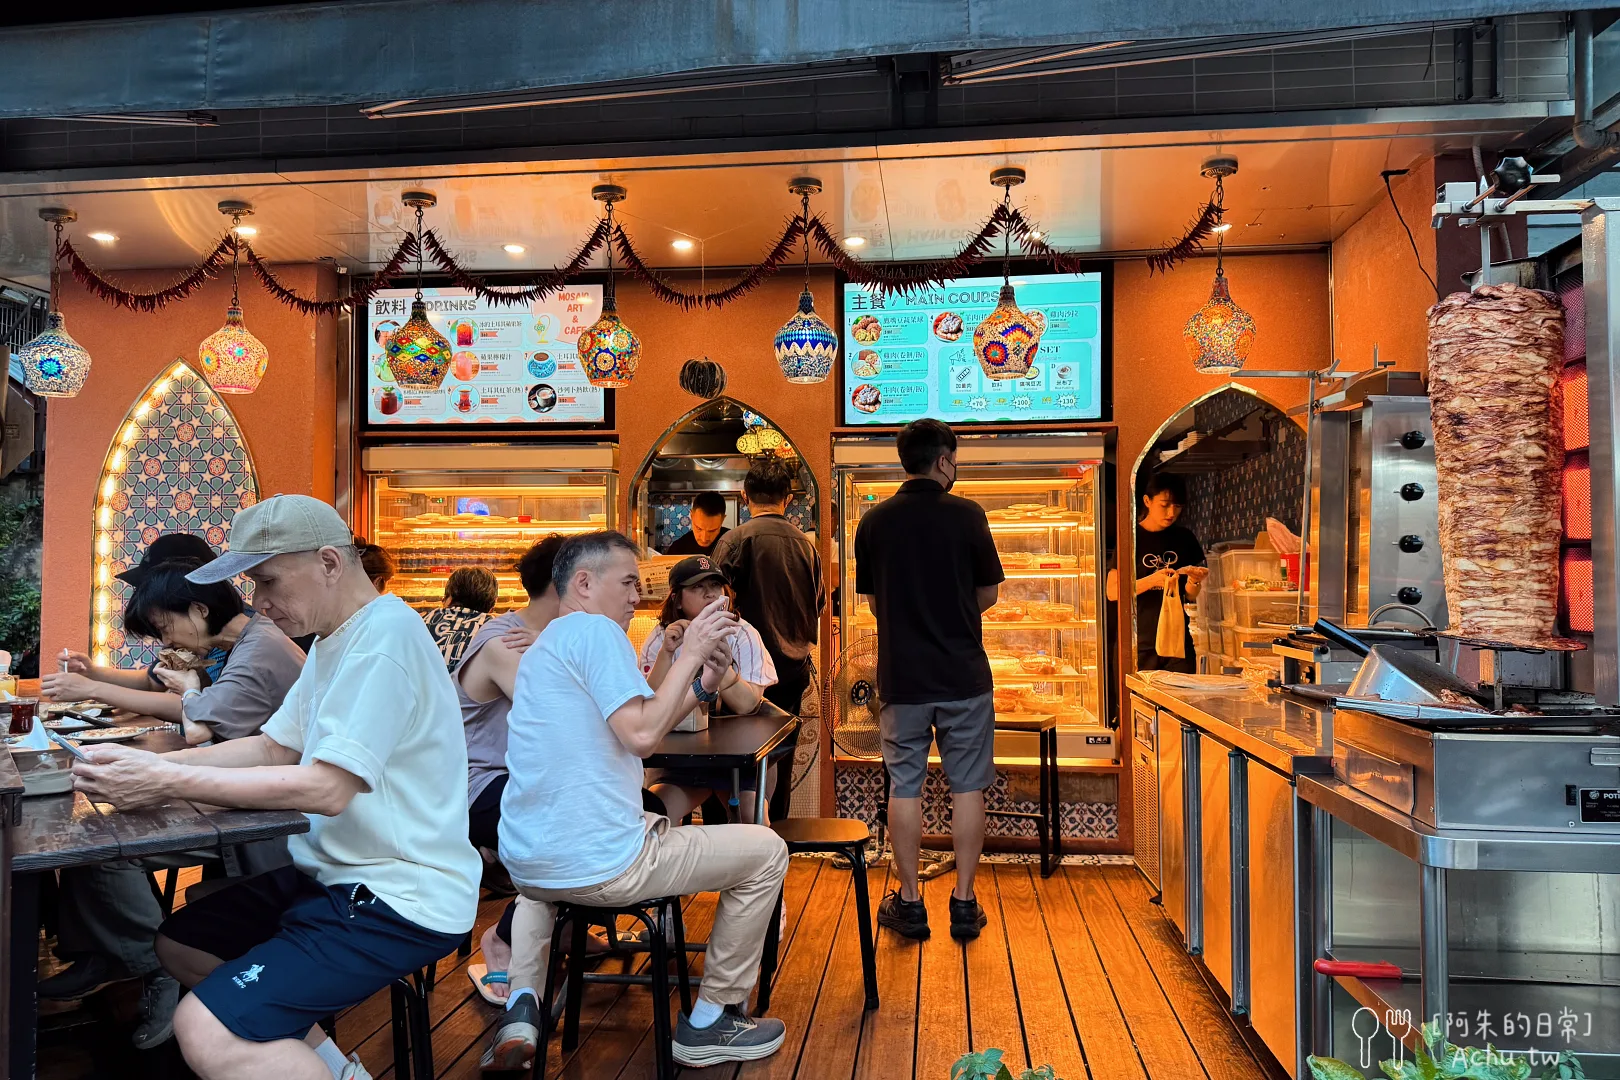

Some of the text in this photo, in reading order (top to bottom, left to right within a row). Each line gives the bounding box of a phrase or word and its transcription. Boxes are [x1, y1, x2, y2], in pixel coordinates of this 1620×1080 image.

[425, 300, 477, 311] DRINKS
[851, 293, 886, 310] 主餐
[906, 293, 945, 305] MAIN
[948, 291, 999, 304] COURS
[374, 299, 407, 315] 飲料
[567, 303, 584, 312] ART
[572, 315, 578, 323] &
[1040, 346, 1061, 354] SET
[334, 621, 352, 636] URBAN
